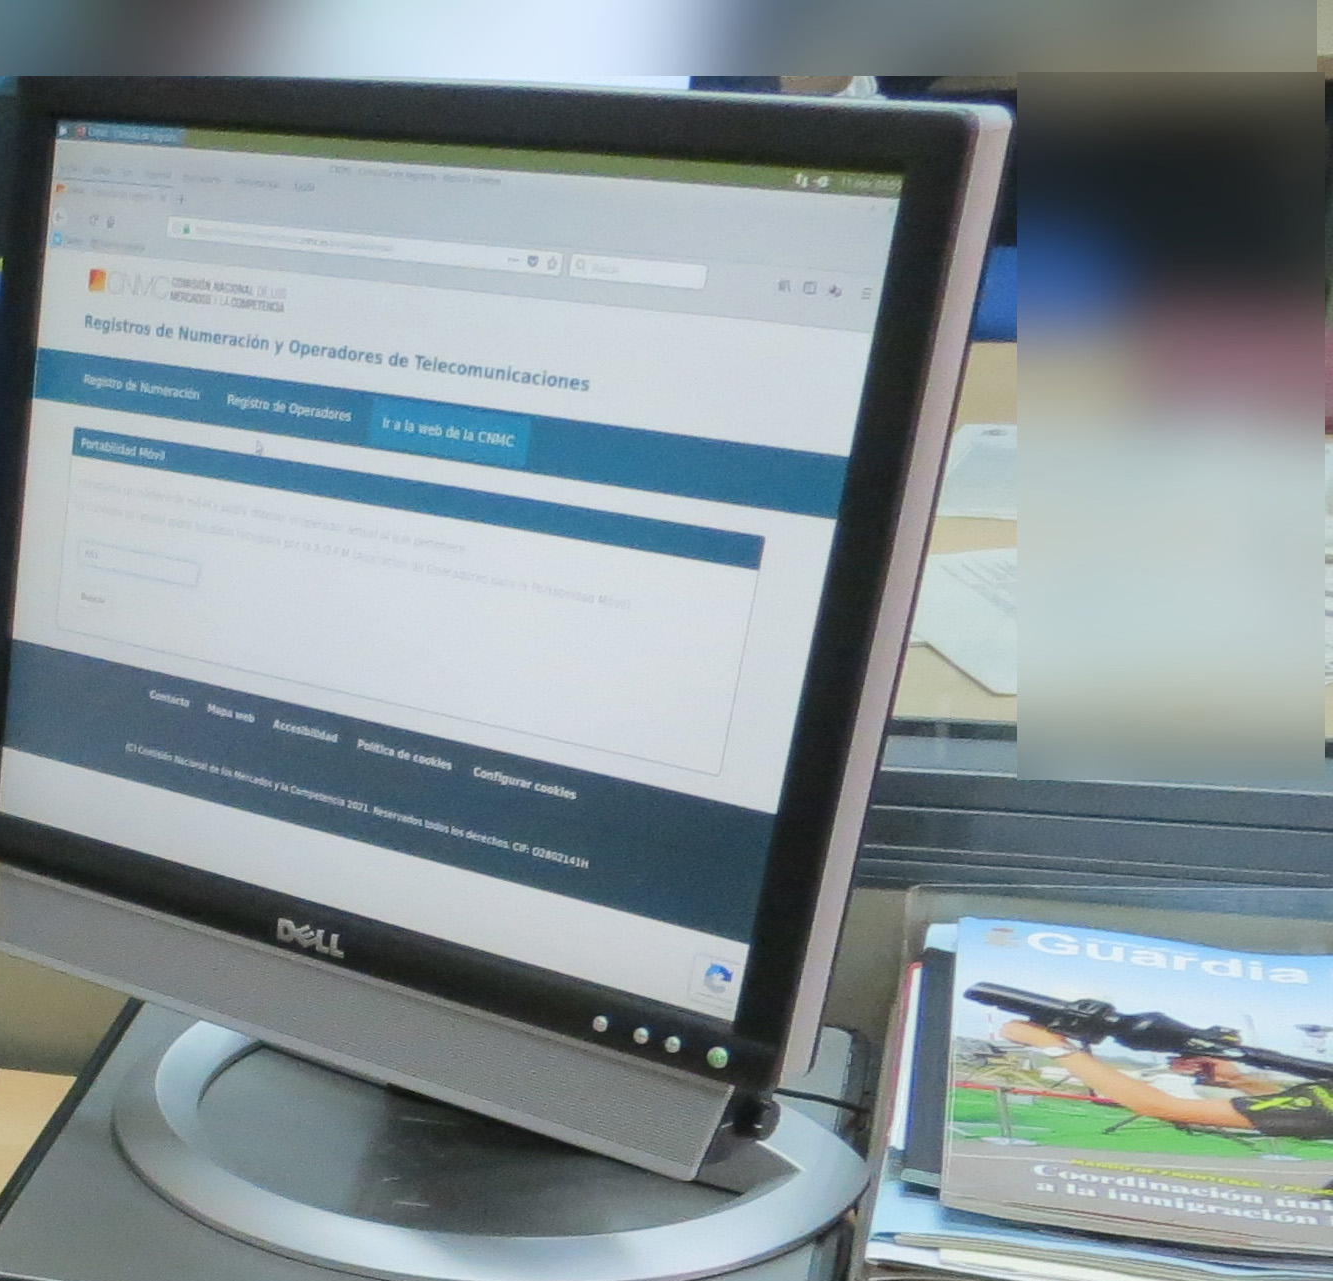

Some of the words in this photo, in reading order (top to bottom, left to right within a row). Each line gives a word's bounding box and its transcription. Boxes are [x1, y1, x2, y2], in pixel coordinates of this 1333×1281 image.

[84, 315, 151, 339] Registros
[156, 322, 174, 338] de
[178, 327, 270, 351] Numeración
[275, 339, 284, 355] y
[289, 339, 382, 366] Operadores
[389, 352, 410, 368] de
[415, 356, 590, 392] Telecomunicaciones
[84, 373, 122, 392] Registro
[125, 380, 137, 393] de
[140, 381, 200, 400] Numeración
[227, 393, 265, 411] Registro
[269, 400, 286, 414] de
[289, 402, 352, 423] Operadores
[382, 416, 390, 429] Ir
[393, 421, 401, 431] a
[405, 419, 415, 433] la
[419, 422, 442, 436] web
[445, 425, 460, 440] de
[463, 428, 474, 442] la
[478, 430, 515, 448] CNMC
[81, 437, 137, 459] Portabilidad
[139, 446, 166, 461] Móvil
[149, 689, 190, 708] Contacto
[207, 703, 233, 720] Mapa
[235, 708, 255, 724] web
[273, 719, 339, 743] Accesibilidad
[357, 739, 395, 758] Política
[398, 748, 411, 761] de
[413, 752, 452, 772] cookies
[474, 766, 532, 790] Configurar
[534, 781, 577, 801] cookies
[234, 770, 273, 789] Mercados
[374, 806, 423, 827] Reservados
[425, 819, 450, 835] todos
[451, 824, 464, 838] los
[277, 918, 344, 958] DELL
[1027, 932, 1309, 985] Guardia
[1033, 1163, 1263, 1205] Coordinación
[1036, 1182, 1055, 1193] a
[1066, 1182, 1097, 1198] la
[1108, 1188, 1319, 1226] inmigración
